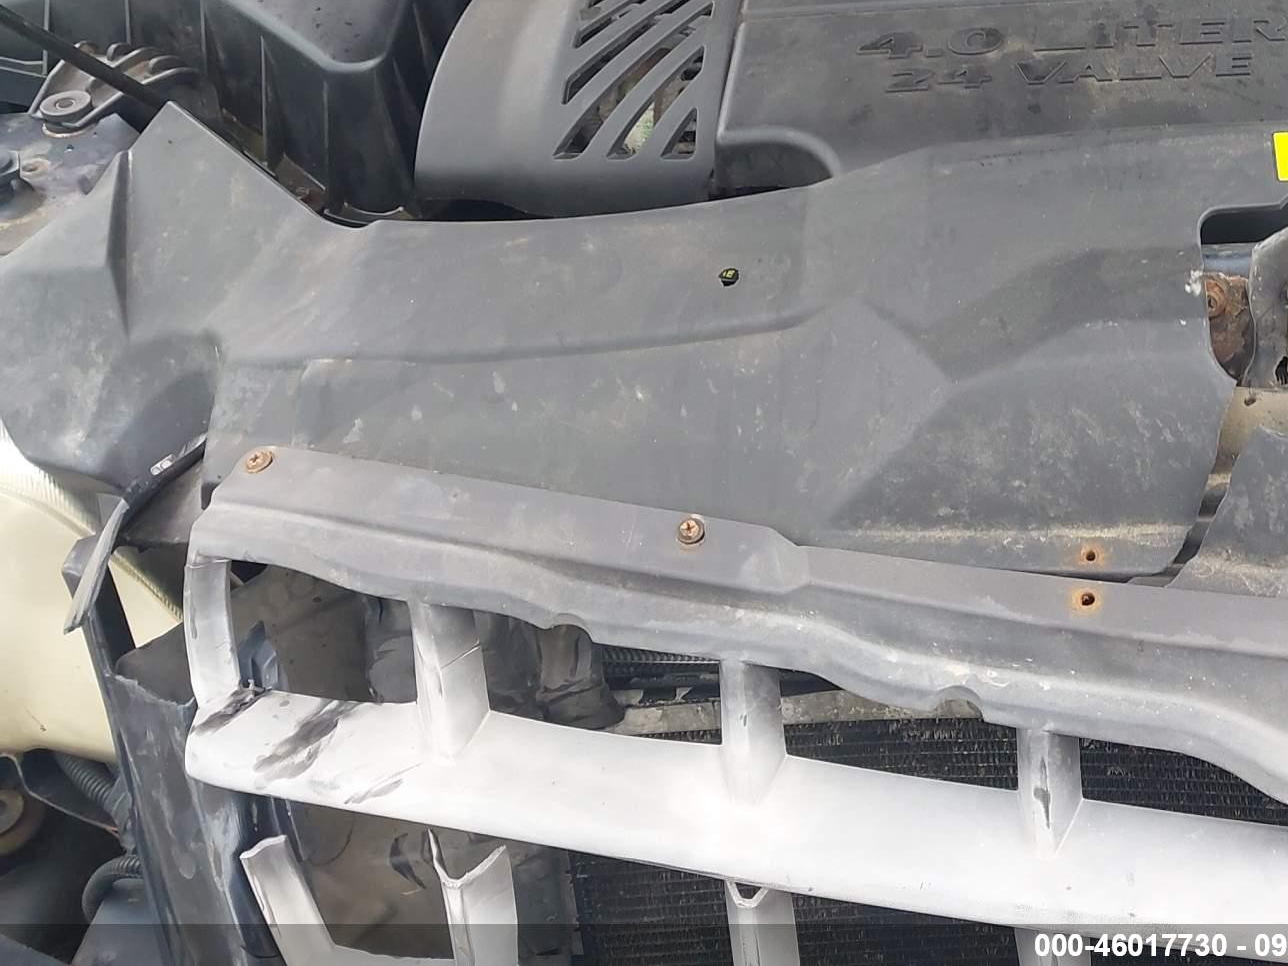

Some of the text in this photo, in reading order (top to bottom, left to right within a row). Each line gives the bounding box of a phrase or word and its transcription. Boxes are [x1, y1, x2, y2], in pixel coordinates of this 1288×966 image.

[856, 16, 1288, 60] 4.0 LITER
[885, 51, 1255, 94] 24 VALVE
